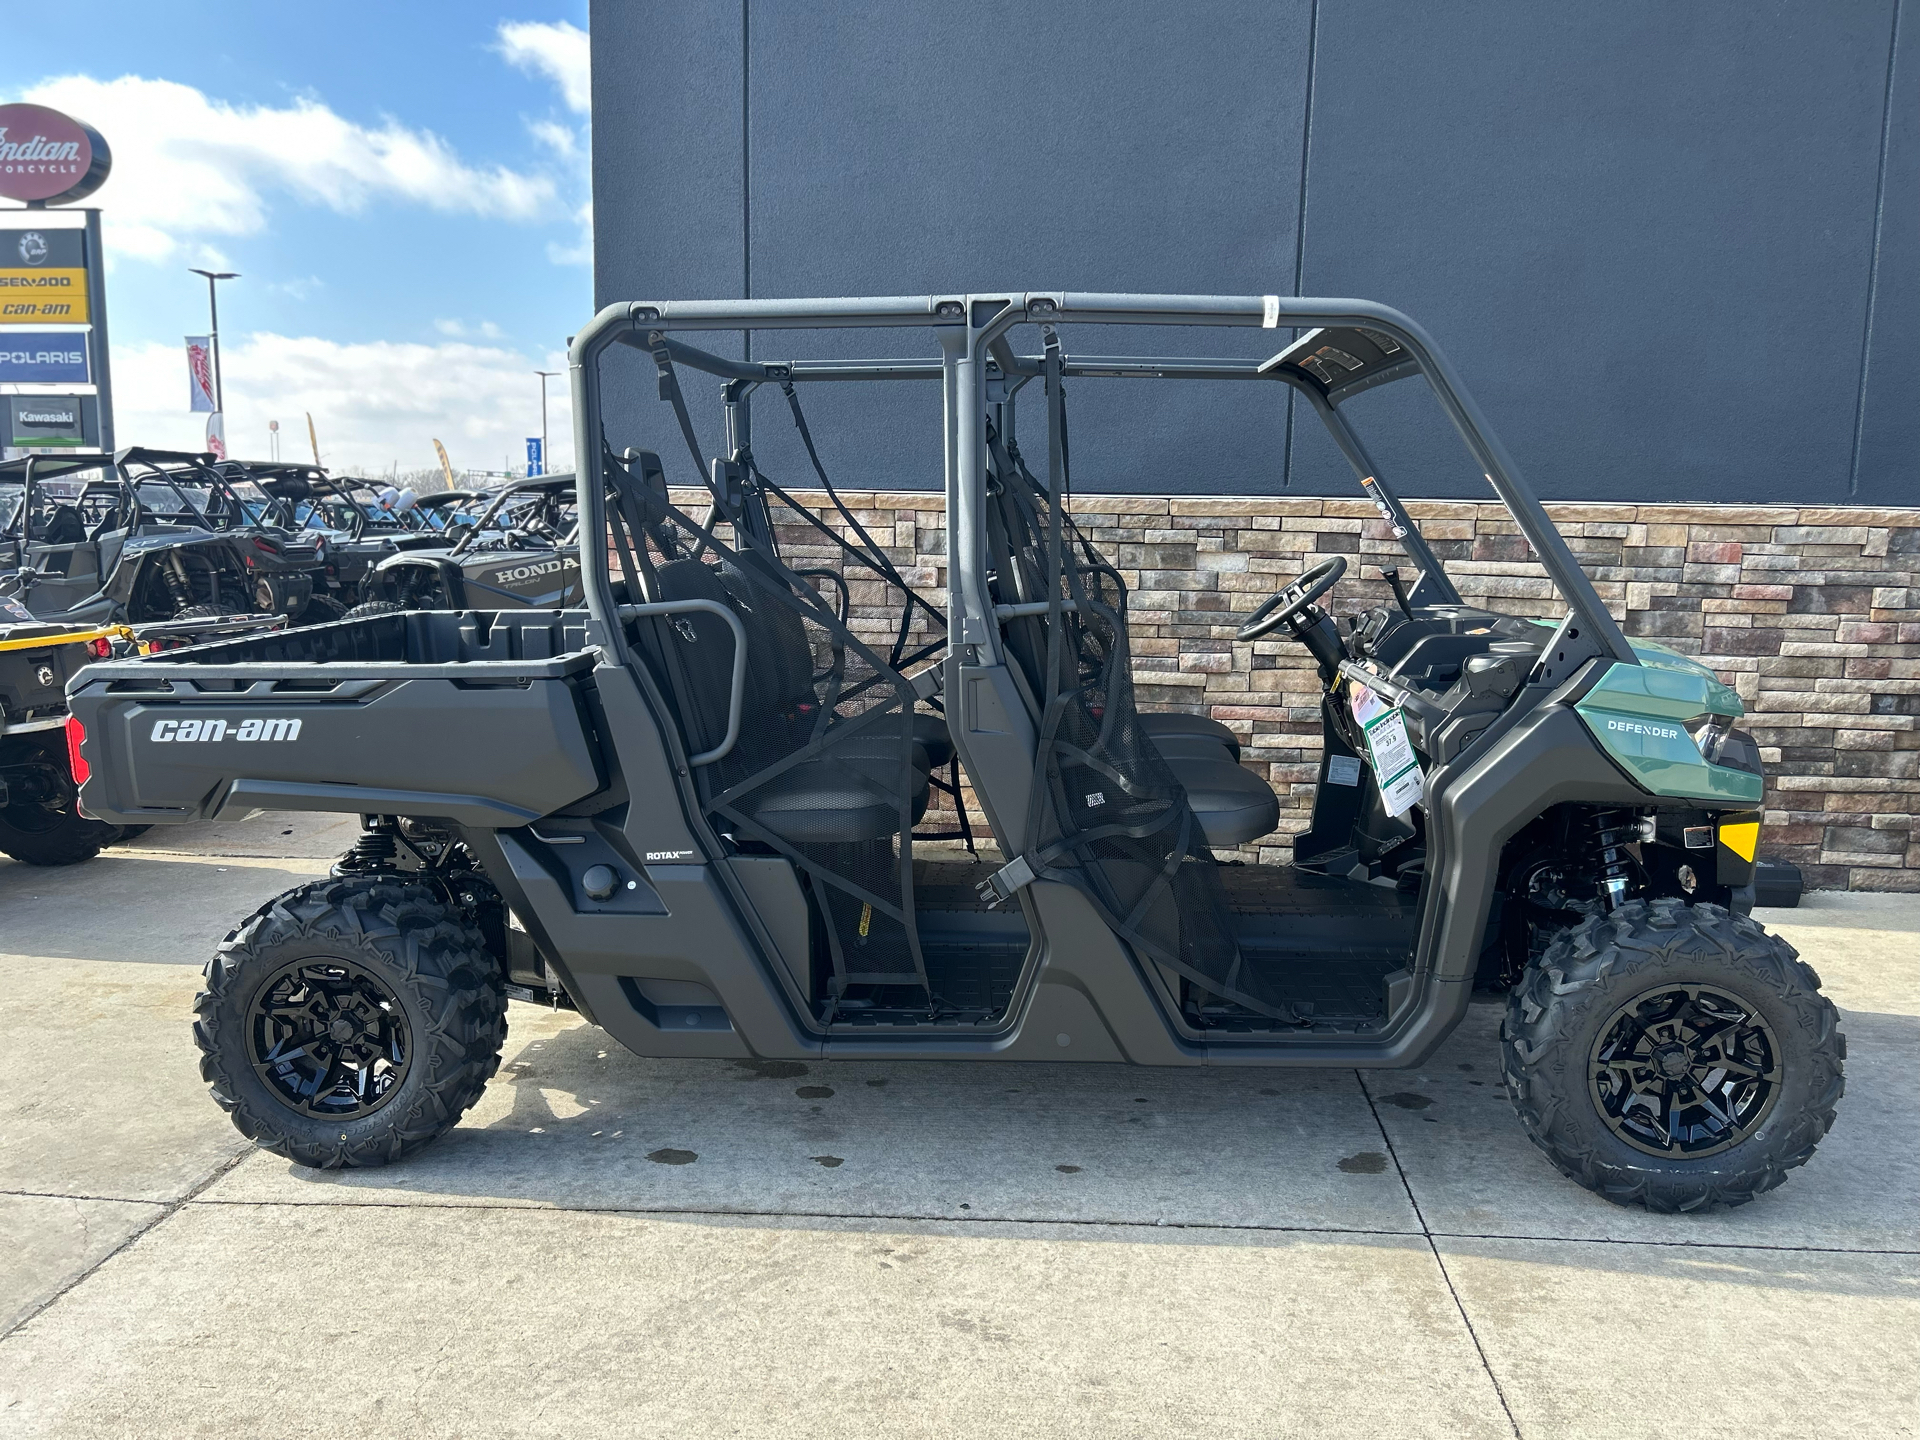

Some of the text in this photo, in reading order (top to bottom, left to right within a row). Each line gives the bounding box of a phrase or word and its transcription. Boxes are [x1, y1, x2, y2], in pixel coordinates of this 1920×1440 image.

[0, 165, 77, 173] ORCYCLE
[2, 304, 71, 315] can-am
[0, 352, 83, 364] POLARIS
[19, 411, 73, 423] Kawasaki
[495, 557, 580, 584] HONDA
[503, 577, 541, 589] TALON
[150, 718, 303, 742] can-am
[1607, 720, 1678, 739] DEFENDER
[646, 850, 680, 860] ROTAX
